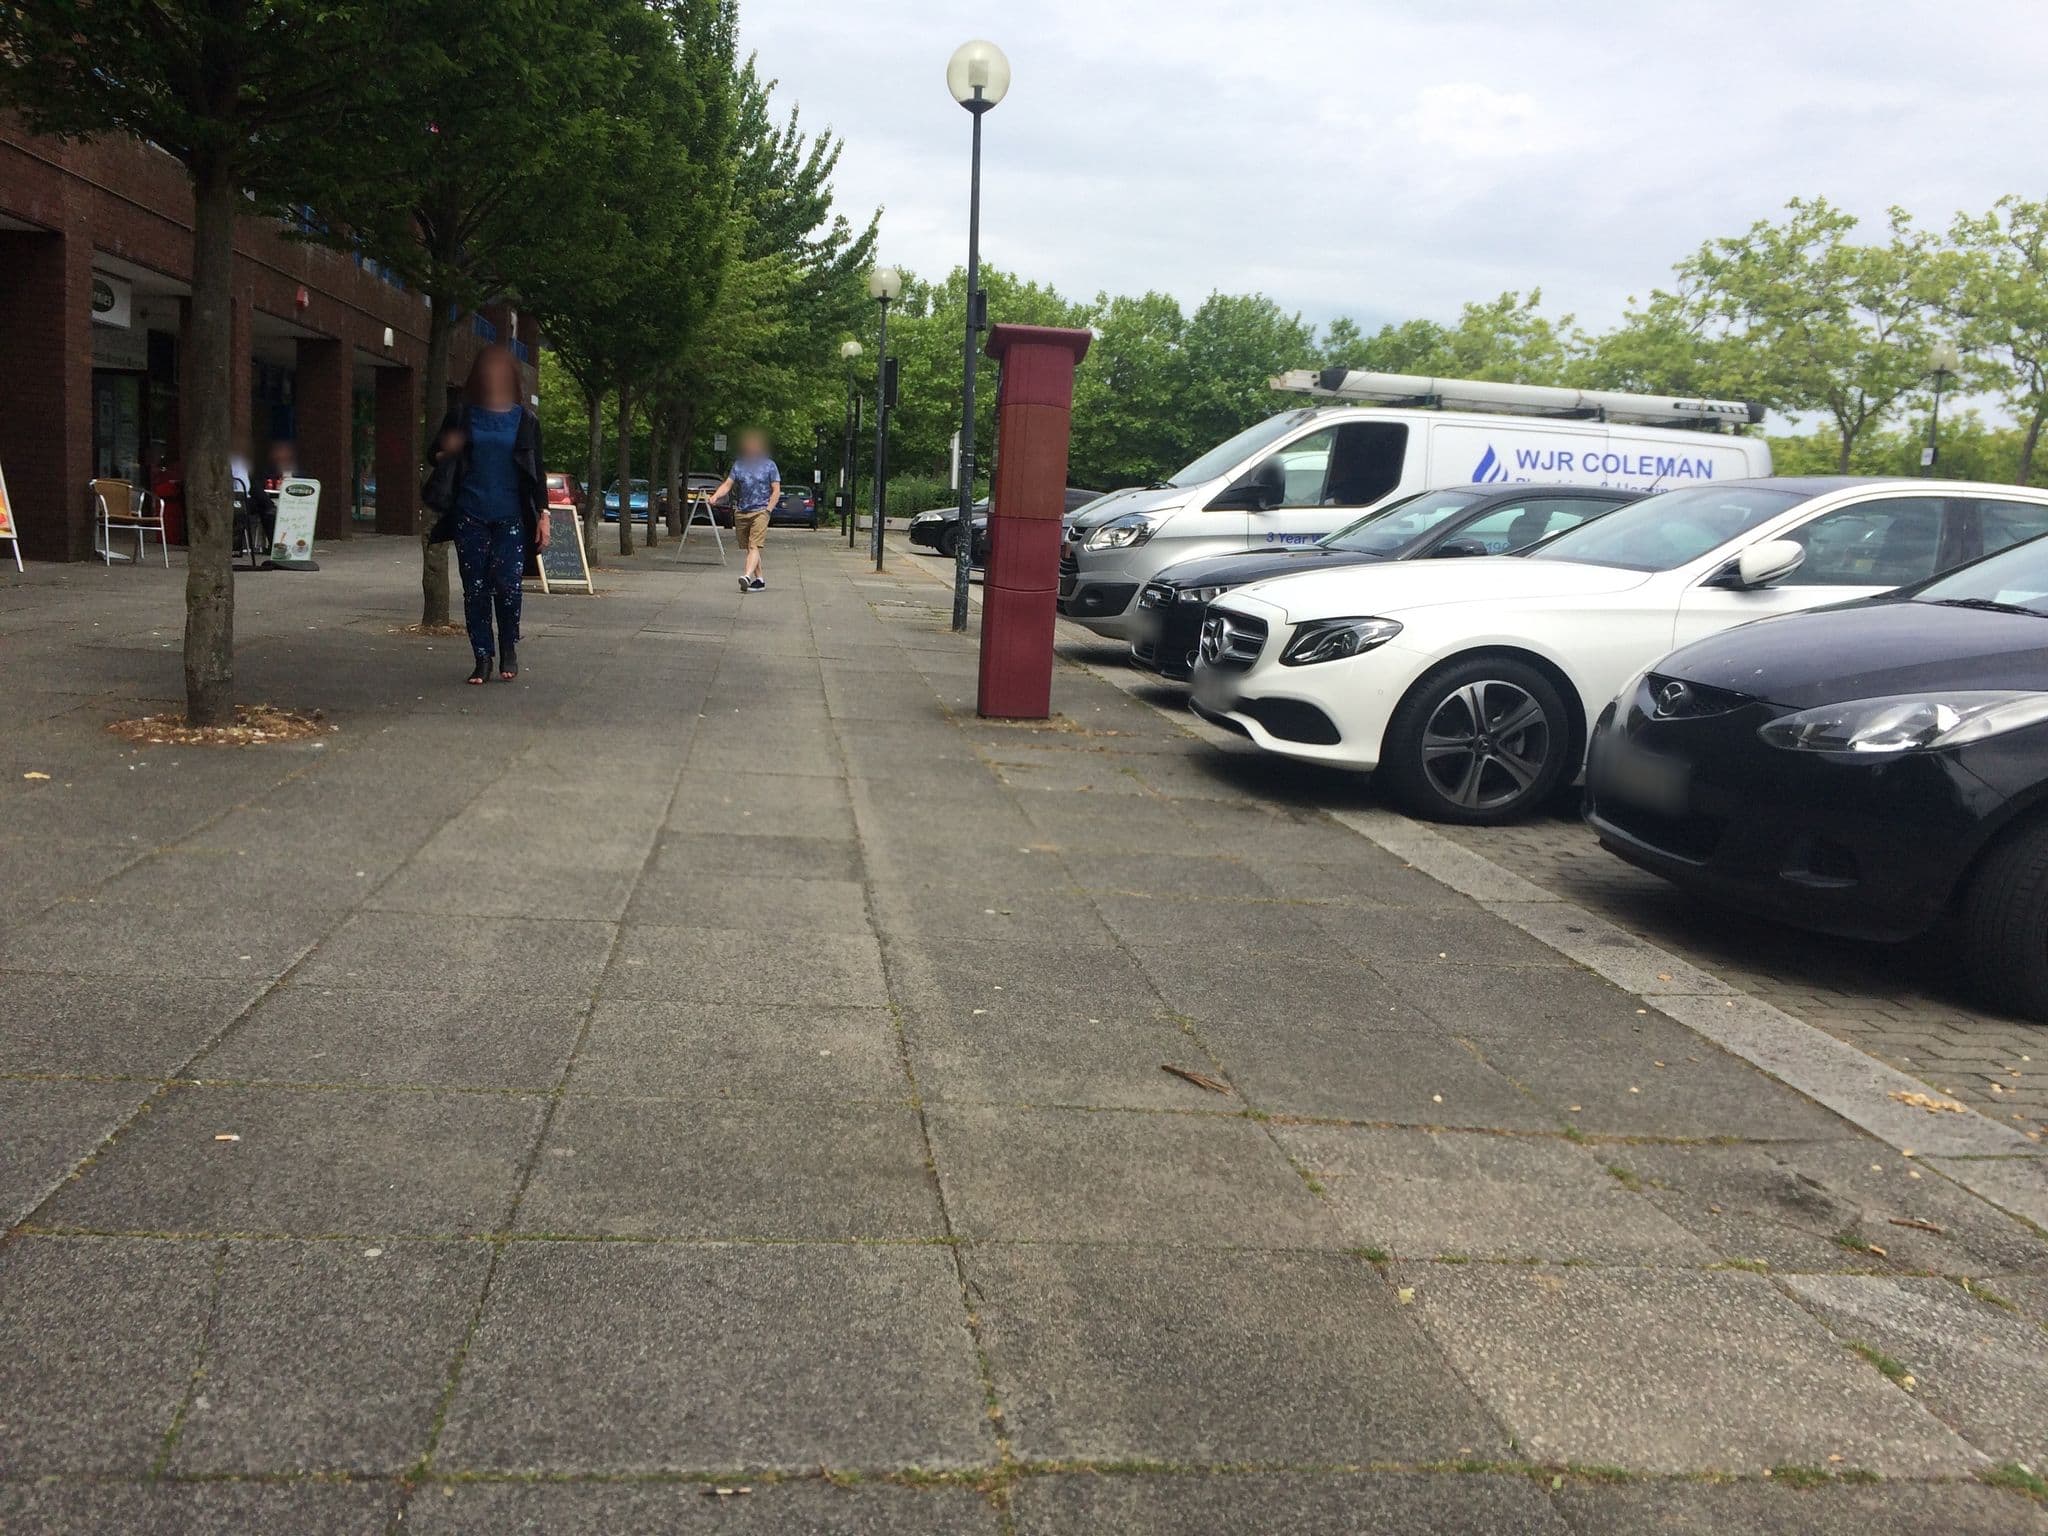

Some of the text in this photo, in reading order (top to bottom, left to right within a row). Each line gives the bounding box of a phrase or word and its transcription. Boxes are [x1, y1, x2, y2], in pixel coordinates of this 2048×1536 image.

[1515, 448, 1714, 480] WJR COLEMAN
[1266, 531, 1275, 543] 3
[1279, 532, 1309, 545] Year
